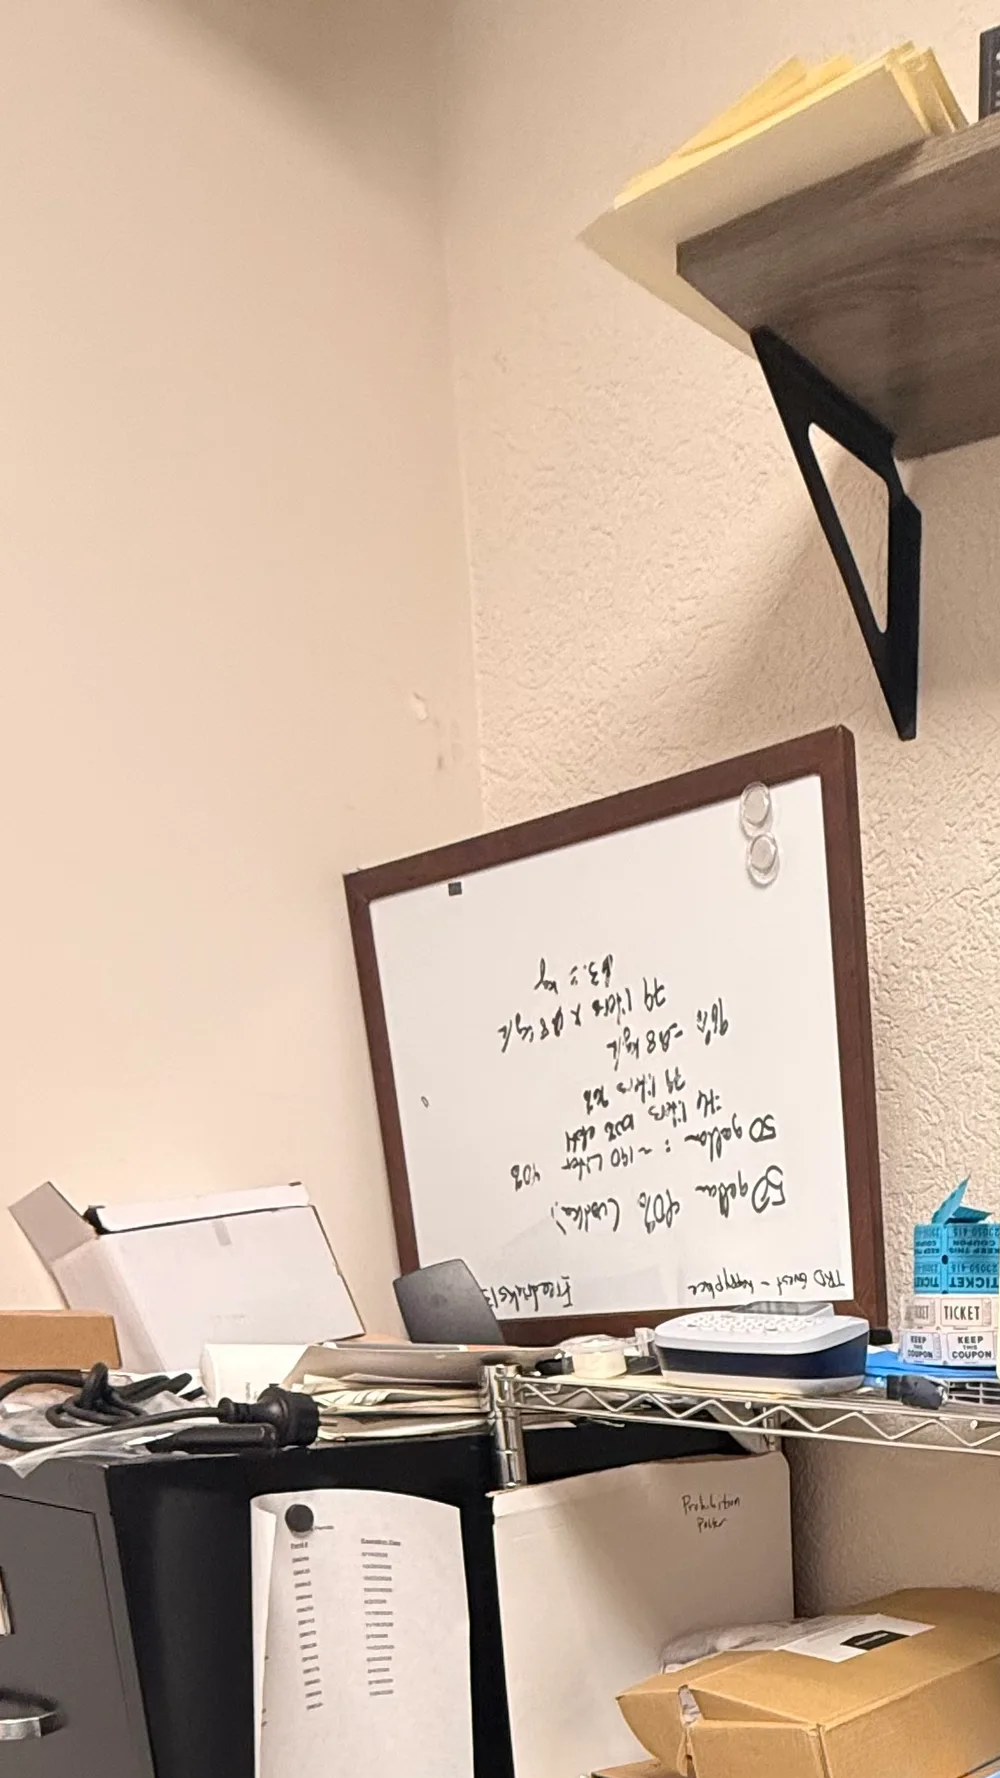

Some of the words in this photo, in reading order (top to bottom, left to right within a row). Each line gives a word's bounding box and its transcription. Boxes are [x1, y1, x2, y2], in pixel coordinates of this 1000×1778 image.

[748, 1113, 777, 1143] 50
[751, 1164, 786, 1214] 50
[812, 1268, 846, 1288] TRD
[948, 1276, 1000, 1289] TICKET
[943, 1305, 981, 1322] TICKET
[957, 1335, 984, 1345] KEEP
[951, 1350, 992, 1360] COUPON
